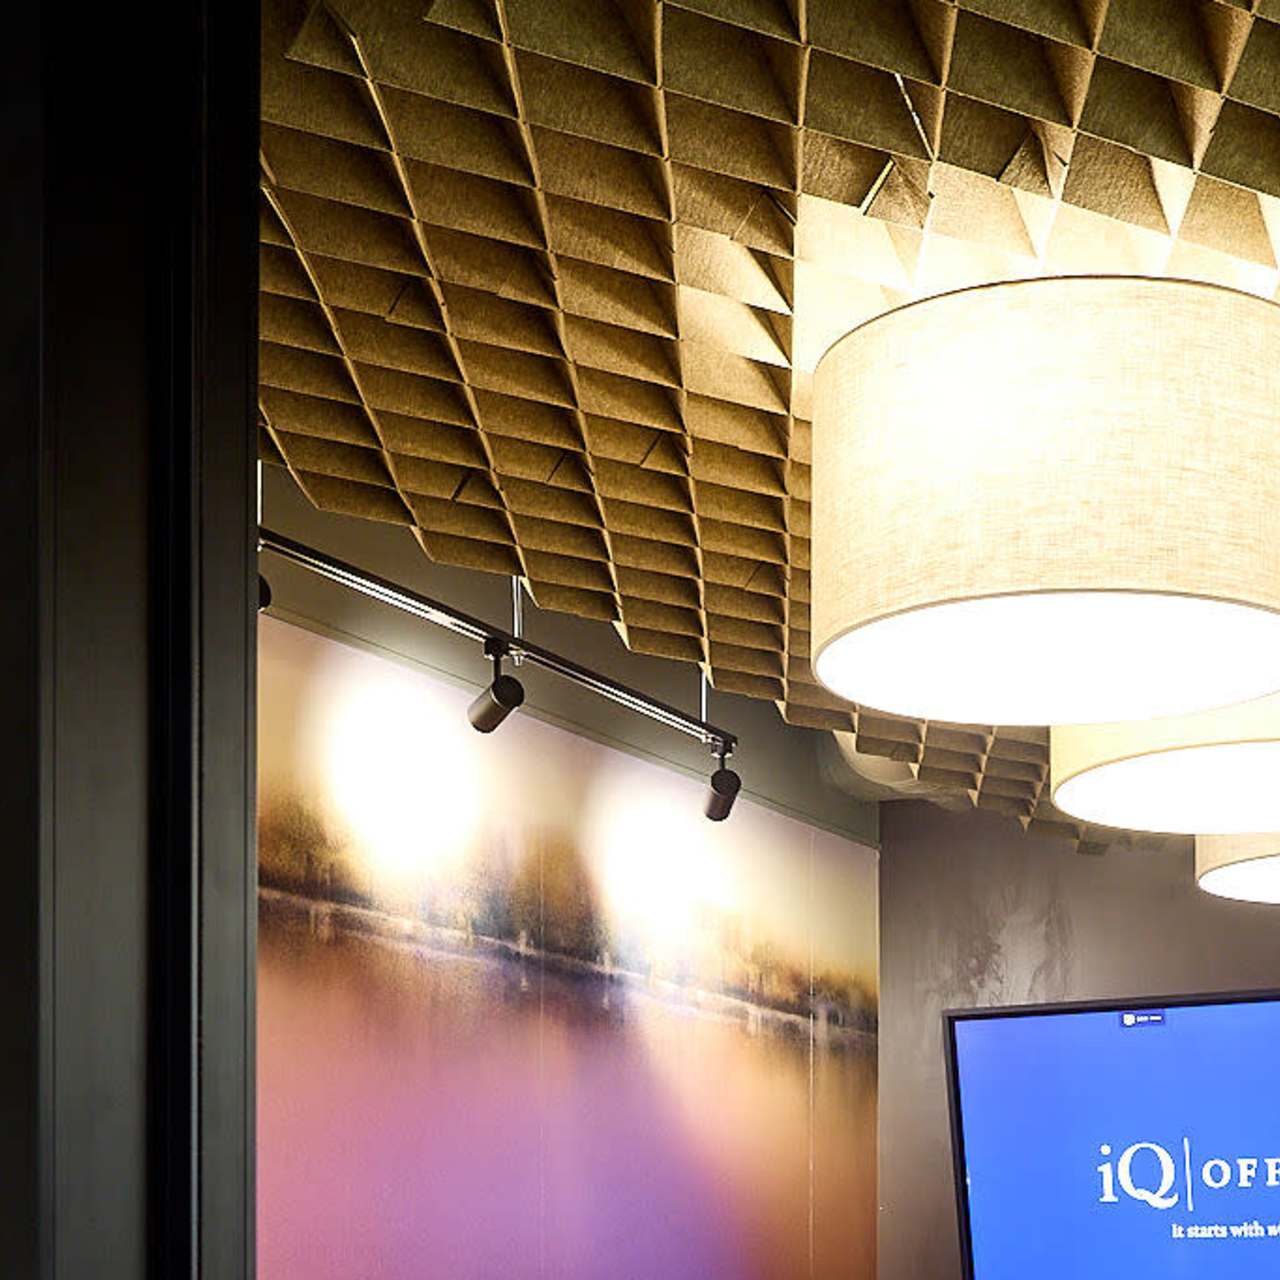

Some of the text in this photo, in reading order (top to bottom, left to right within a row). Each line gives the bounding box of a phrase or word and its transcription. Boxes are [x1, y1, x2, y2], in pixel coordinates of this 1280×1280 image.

[1096, 1142, 1180, 1210] iQ
[1171, 1223, 1184, 1239] It
[1187, 1222, 1228, 1239] starts
[1230, 1220, 1265, 1238] with
